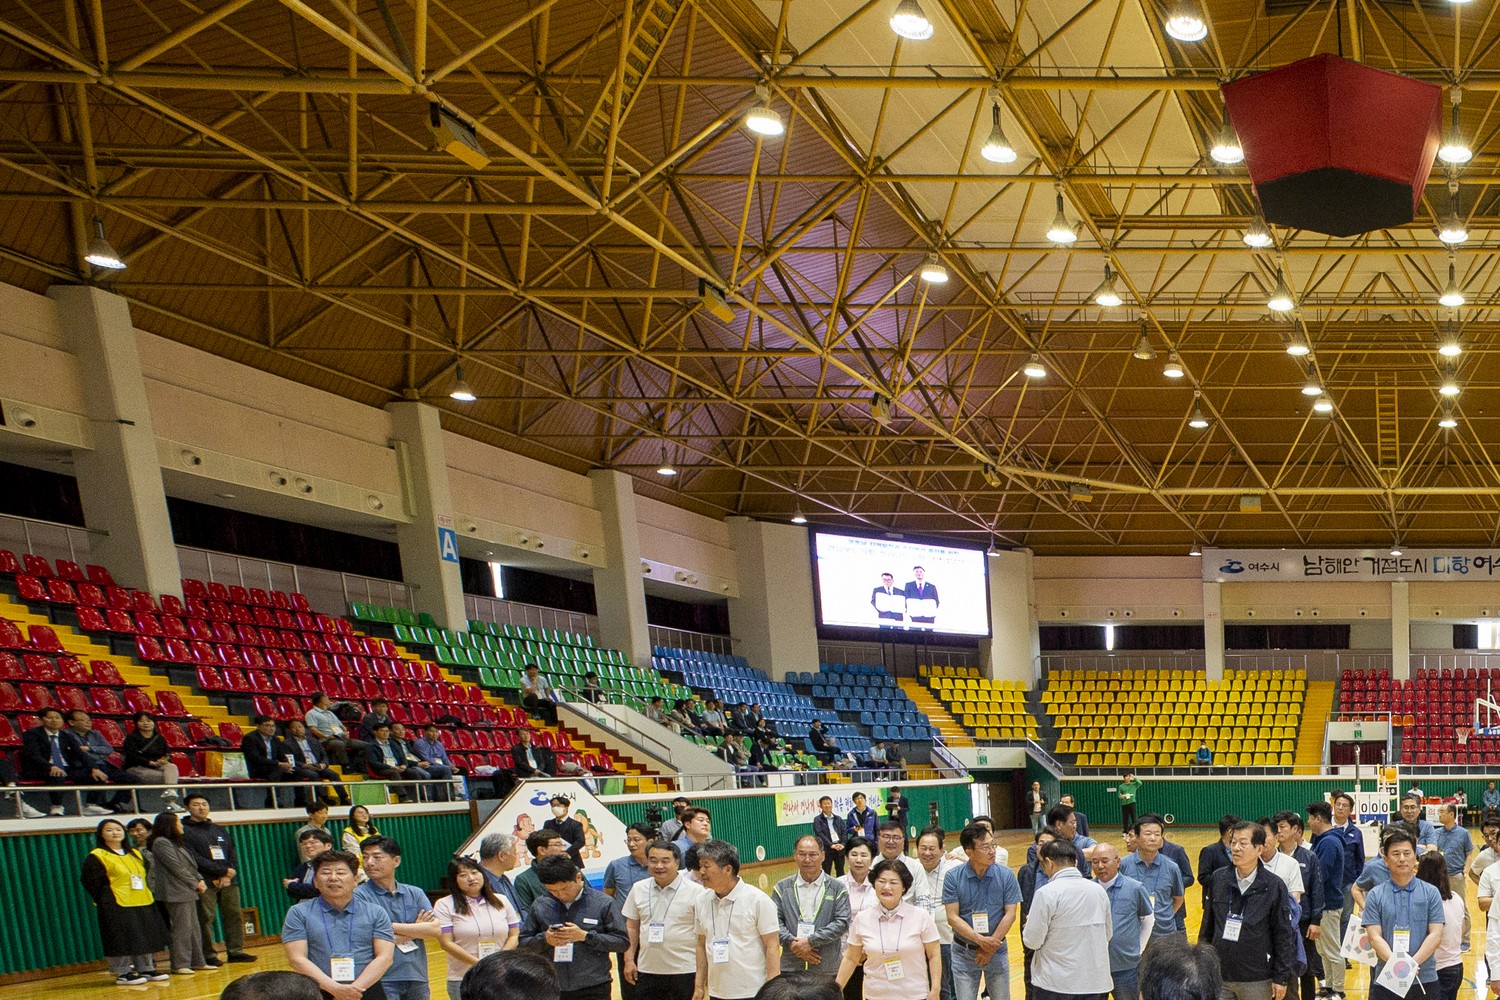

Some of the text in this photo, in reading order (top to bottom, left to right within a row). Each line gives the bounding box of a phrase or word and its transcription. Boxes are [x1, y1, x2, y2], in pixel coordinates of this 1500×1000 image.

[443, 532, 457, 559] A
[1248, 562, 1280, 572] 여수시
[1302, 556, 1360, 576] 남해안
[1362, 557, 1428, 576] 거점도시
